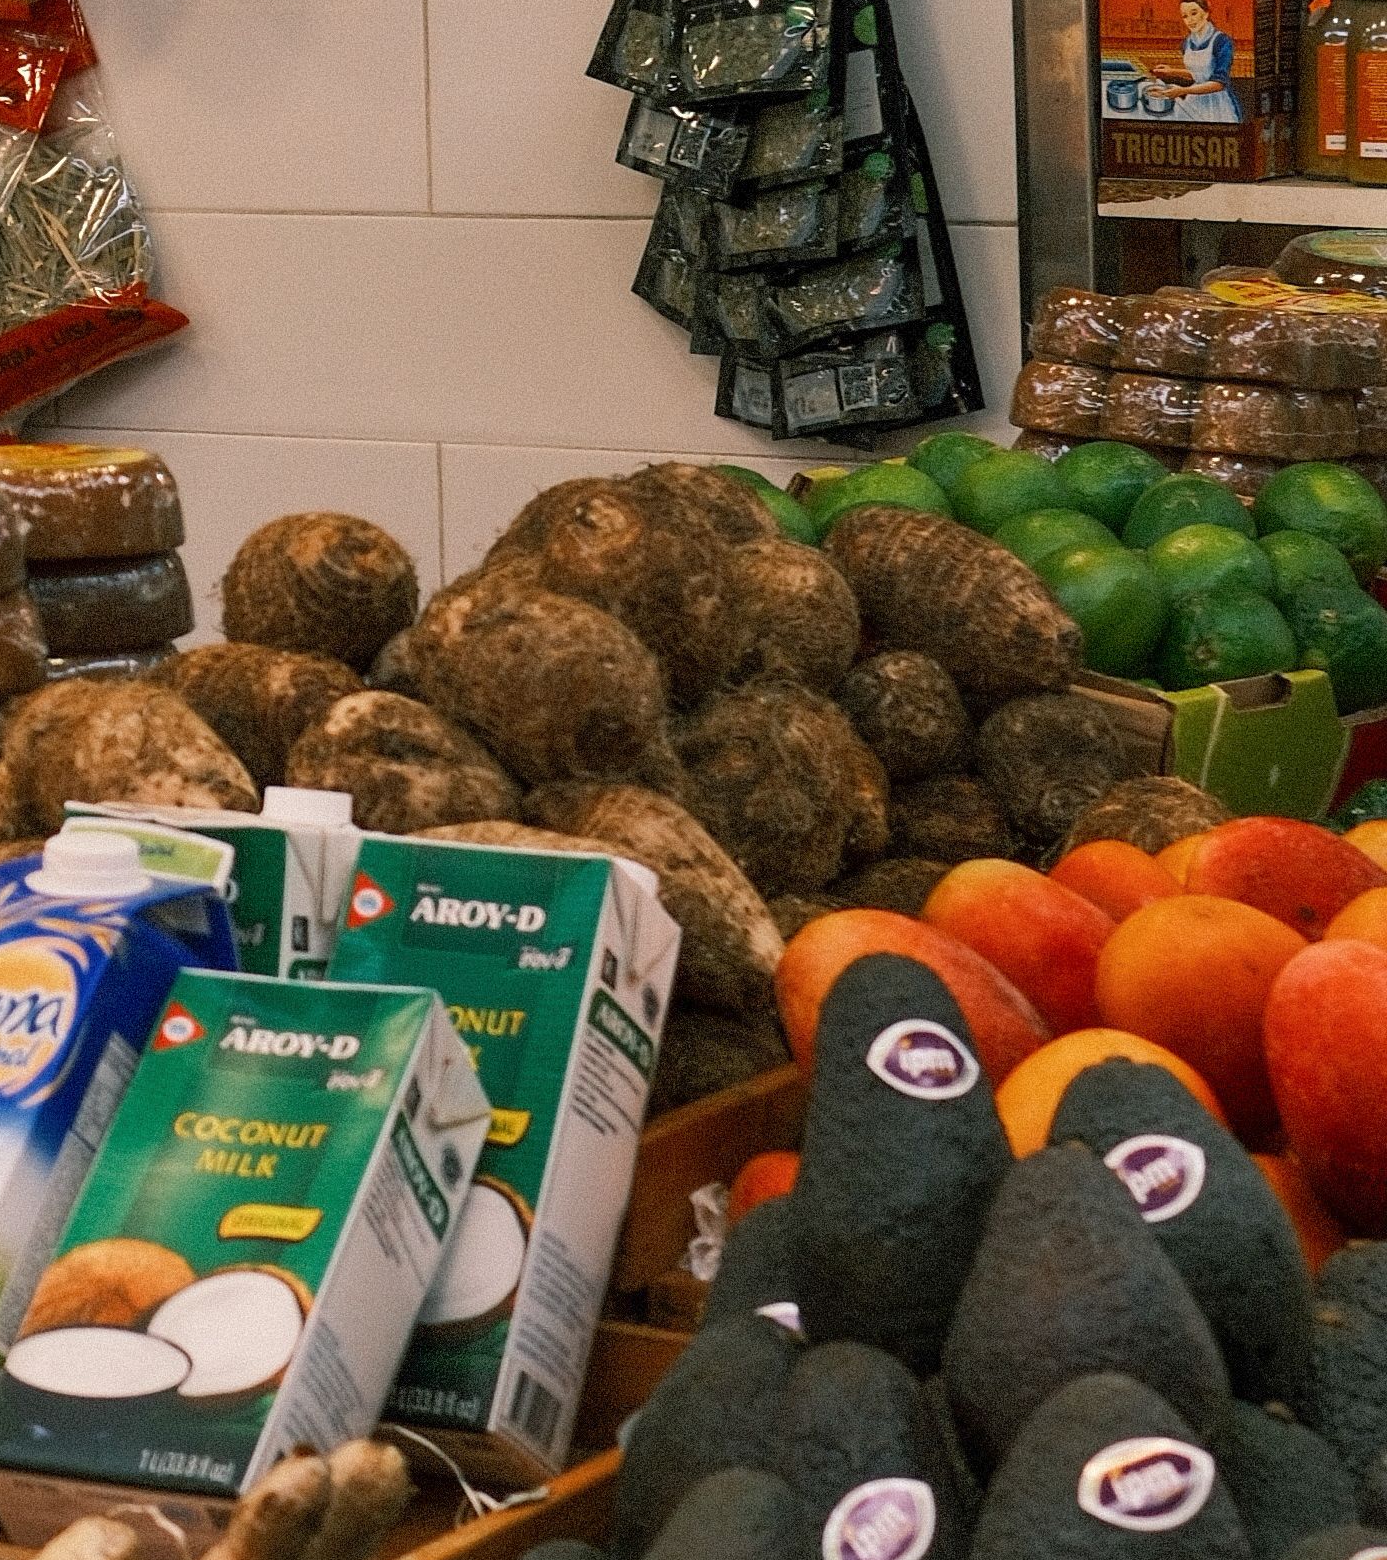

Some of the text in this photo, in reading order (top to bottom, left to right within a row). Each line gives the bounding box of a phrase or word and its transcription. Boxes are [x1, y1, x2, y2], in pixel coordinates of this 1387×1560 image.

[1111, 131, 1243, 172] TRIGUISAR
[410, 895, 545, 933] AROY-D
[221, 1026, 360, 1060] AROY-D
[173, 1110, 328, 1150] COCONUT
[197, 1150, 279, 1181] MILK
